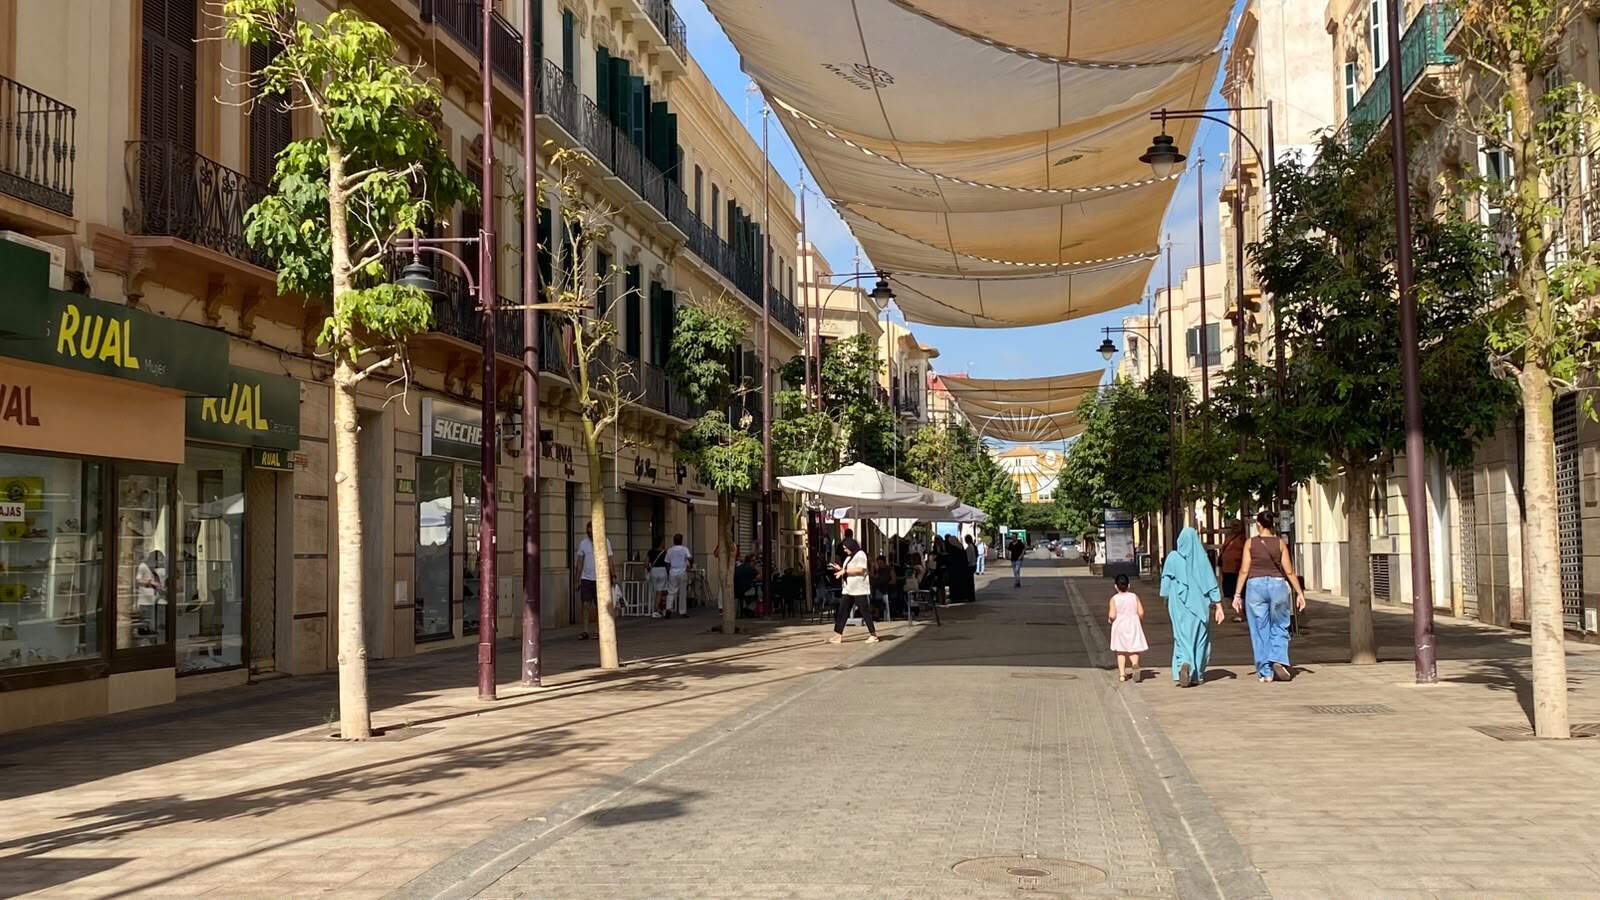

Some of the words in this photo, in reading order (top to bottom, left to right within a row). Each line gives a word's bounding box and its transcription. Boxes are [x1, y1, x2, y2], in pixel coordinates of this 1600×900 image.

[57, 304, 139, 369] RUAL
[434, 418, 482, 446] SKECHE
[262, 451, 281, 467] RUAL
